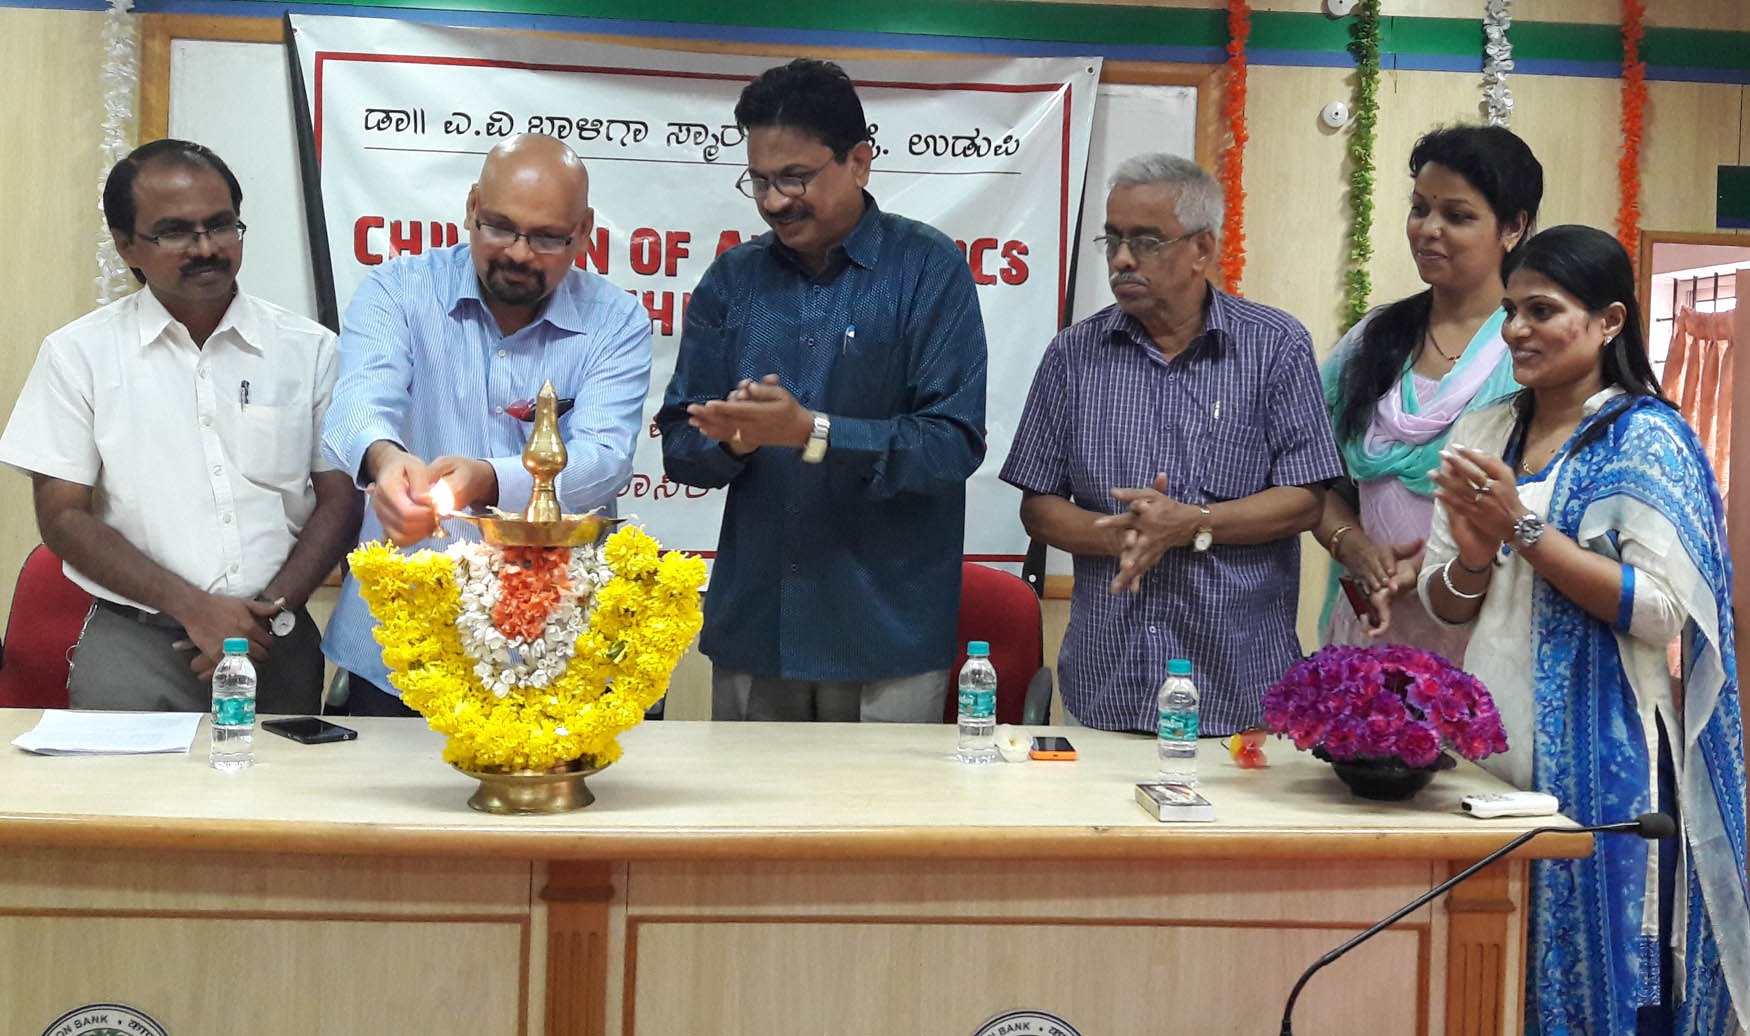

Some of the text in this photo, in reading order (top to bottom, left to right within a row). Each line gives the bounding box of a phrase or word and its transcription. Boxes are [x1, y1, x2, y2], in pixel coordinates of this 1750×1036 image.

[908, 126, 1021, 159] ಉಡುಪಿ
[629, 227, 692, 277] OF
[73, 1014, 109, 1029] BANK
[997, 1021, 1031, 1036] BANK
